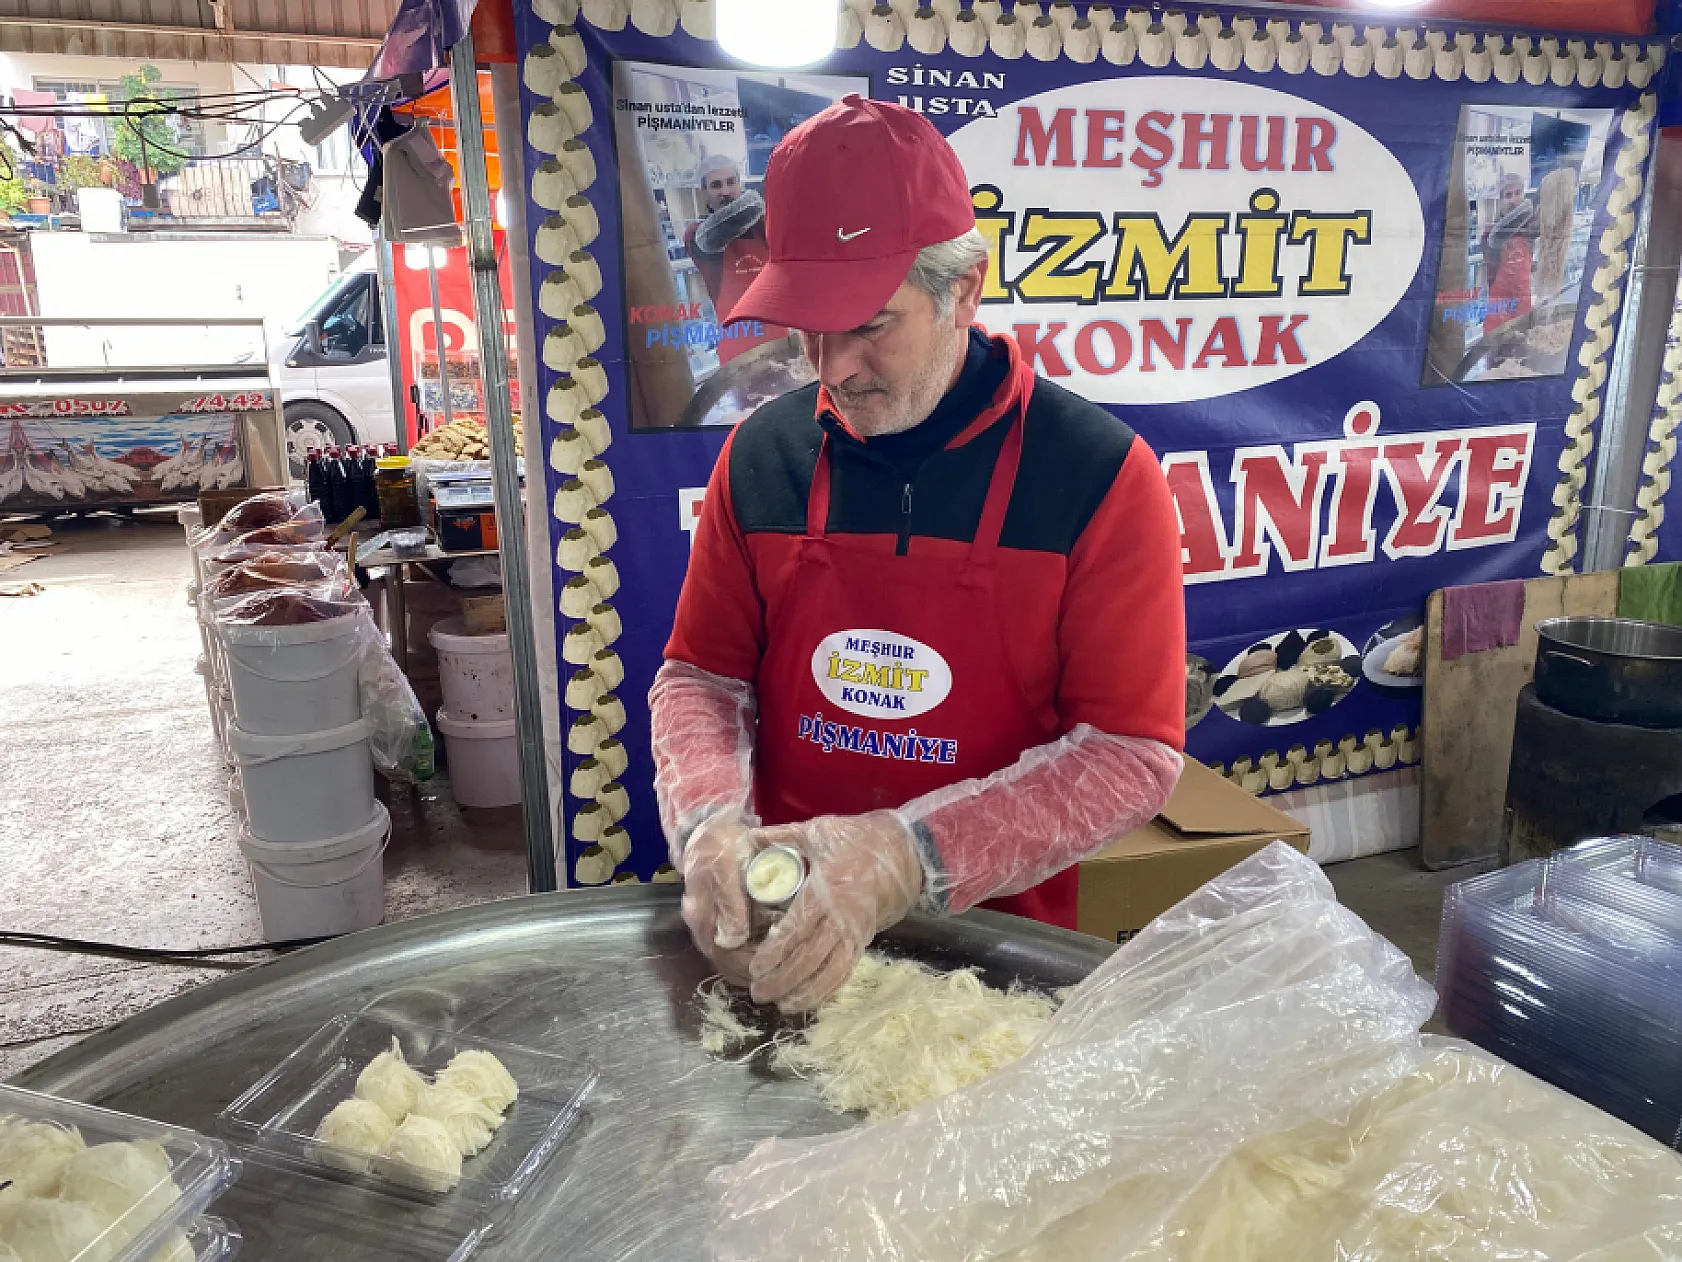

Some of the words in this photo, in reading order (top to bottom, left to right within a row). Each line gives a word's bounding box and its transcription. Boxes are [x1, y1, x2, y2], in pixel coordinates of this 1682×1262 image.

[886, 63, 1006, 89] SİNAN
[616, 98, 652, 111] Sinan
[1013, 106, 1337, 188] MEŞHUR
[974, 183, 1372, 305] İZMİT
[629, 302, 702, 324] KONAK
[1012, 313, 1309, 378] KONAK
[845, 637, 915, 659] MEŞHUR
[827, 651, 928, 693] İZMİT
[841, 687, 906, 710] KONAK
[798, 711, 958, 764] PİŞMANİYE
